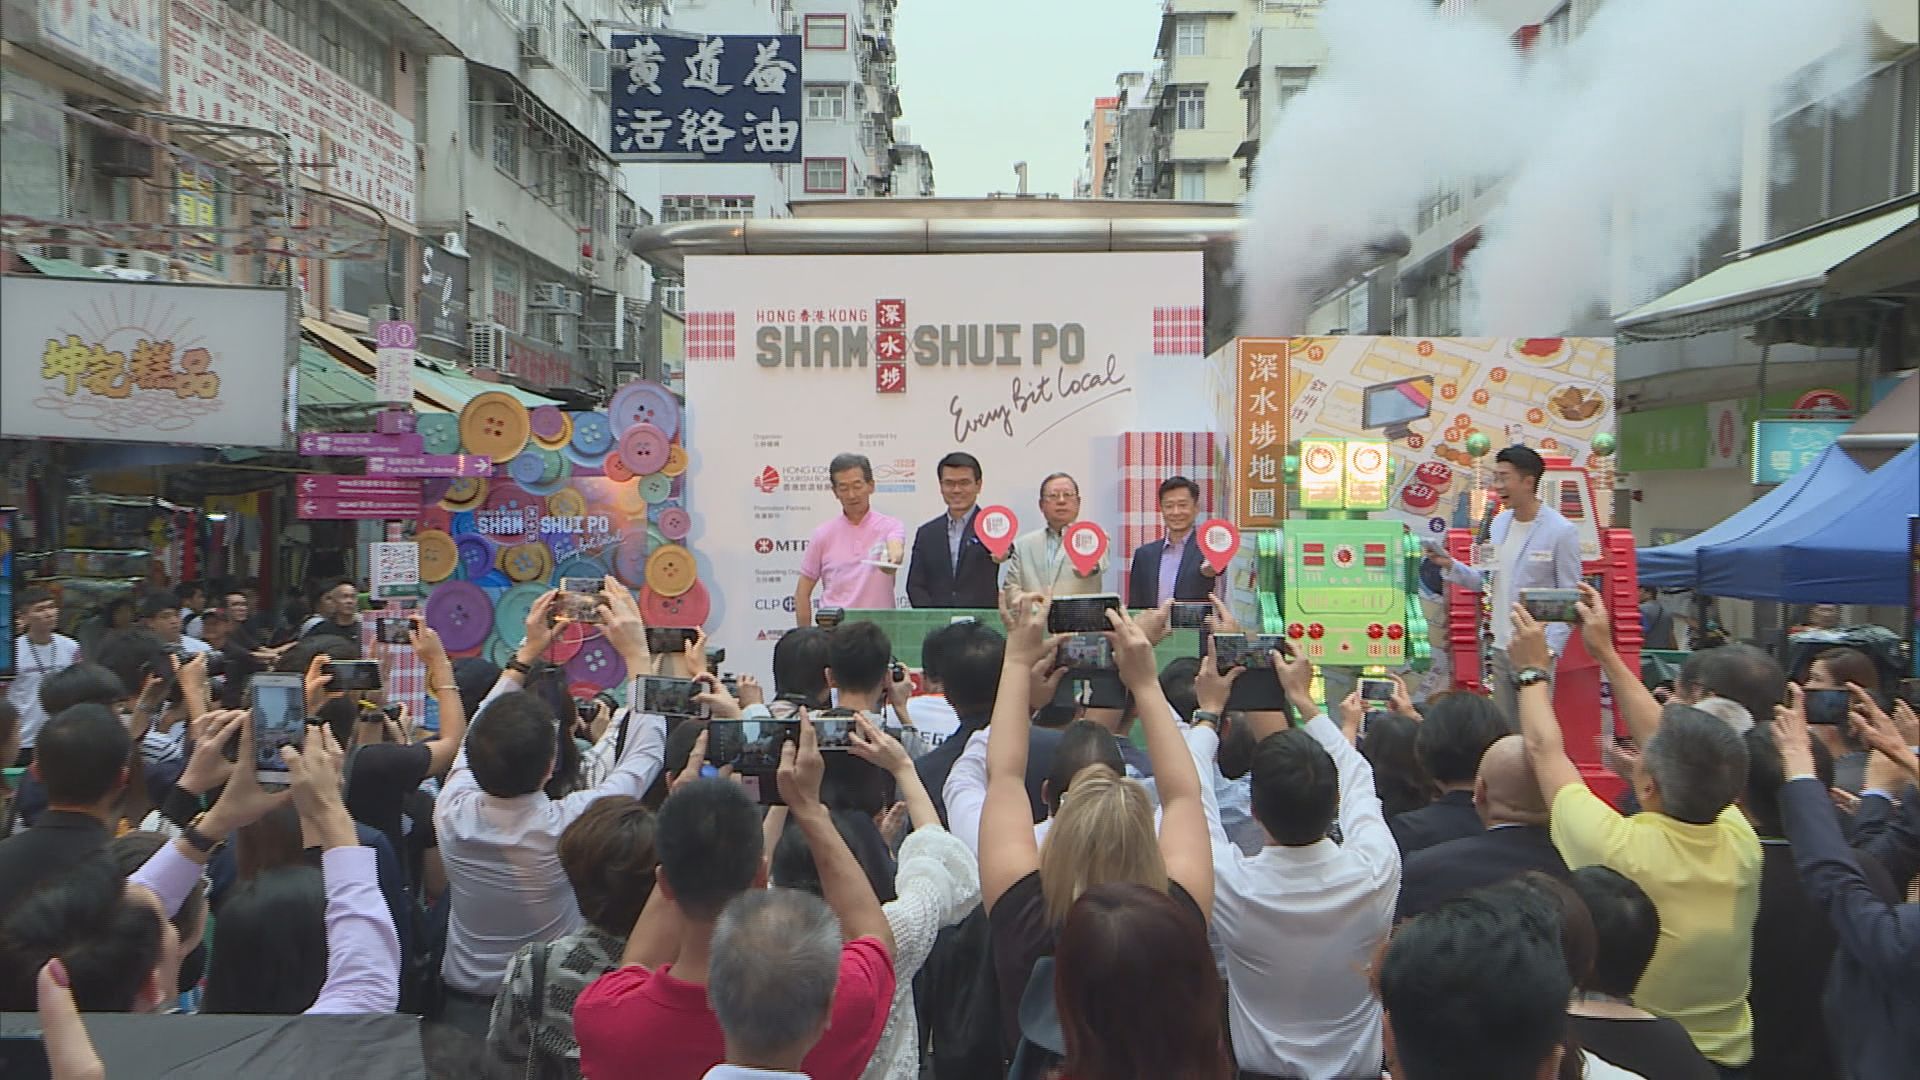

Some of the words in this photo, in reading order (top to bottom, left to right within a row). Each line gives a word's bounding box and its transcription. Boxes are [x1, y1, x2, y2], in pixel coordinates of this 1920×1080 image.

[203, 44, 233, 78] QUILT
[239, 65, 269, 98] PANTY
[276, 86, 304, 118] TOWEL
[298, 76, 331, 110] SERVICE
[615, 107, 799, 154] 活絡油
[757, 310, 796, 322] HONG
[799, 309, 826, 322] 香港
[829, 310, 867, 322] KONG
[756, 325, 867, 368] SHAM
[878, 303, 903, 391] 深水埗
[913, 324, 1023, 367] SHUI
[1032, 323, 1086, 365] PO
[949, 395, 1013, 443] Every
[1012, 376, 1053, 413] Bit
[1248, 353, 1278, 518] 深水埗地圖
[783, 466, 811, 474] HONG
[813, 466, 831, 474] KON
[1430, 464, 1450, 480] D2
[1418, 486, 1435, 500] D1
[479, 516, 524, 534] SHAM
[541, 516, 585, 534] SHUI
[589, 517, 609, 533] PO
[755, 599, 780, 610] CLP
